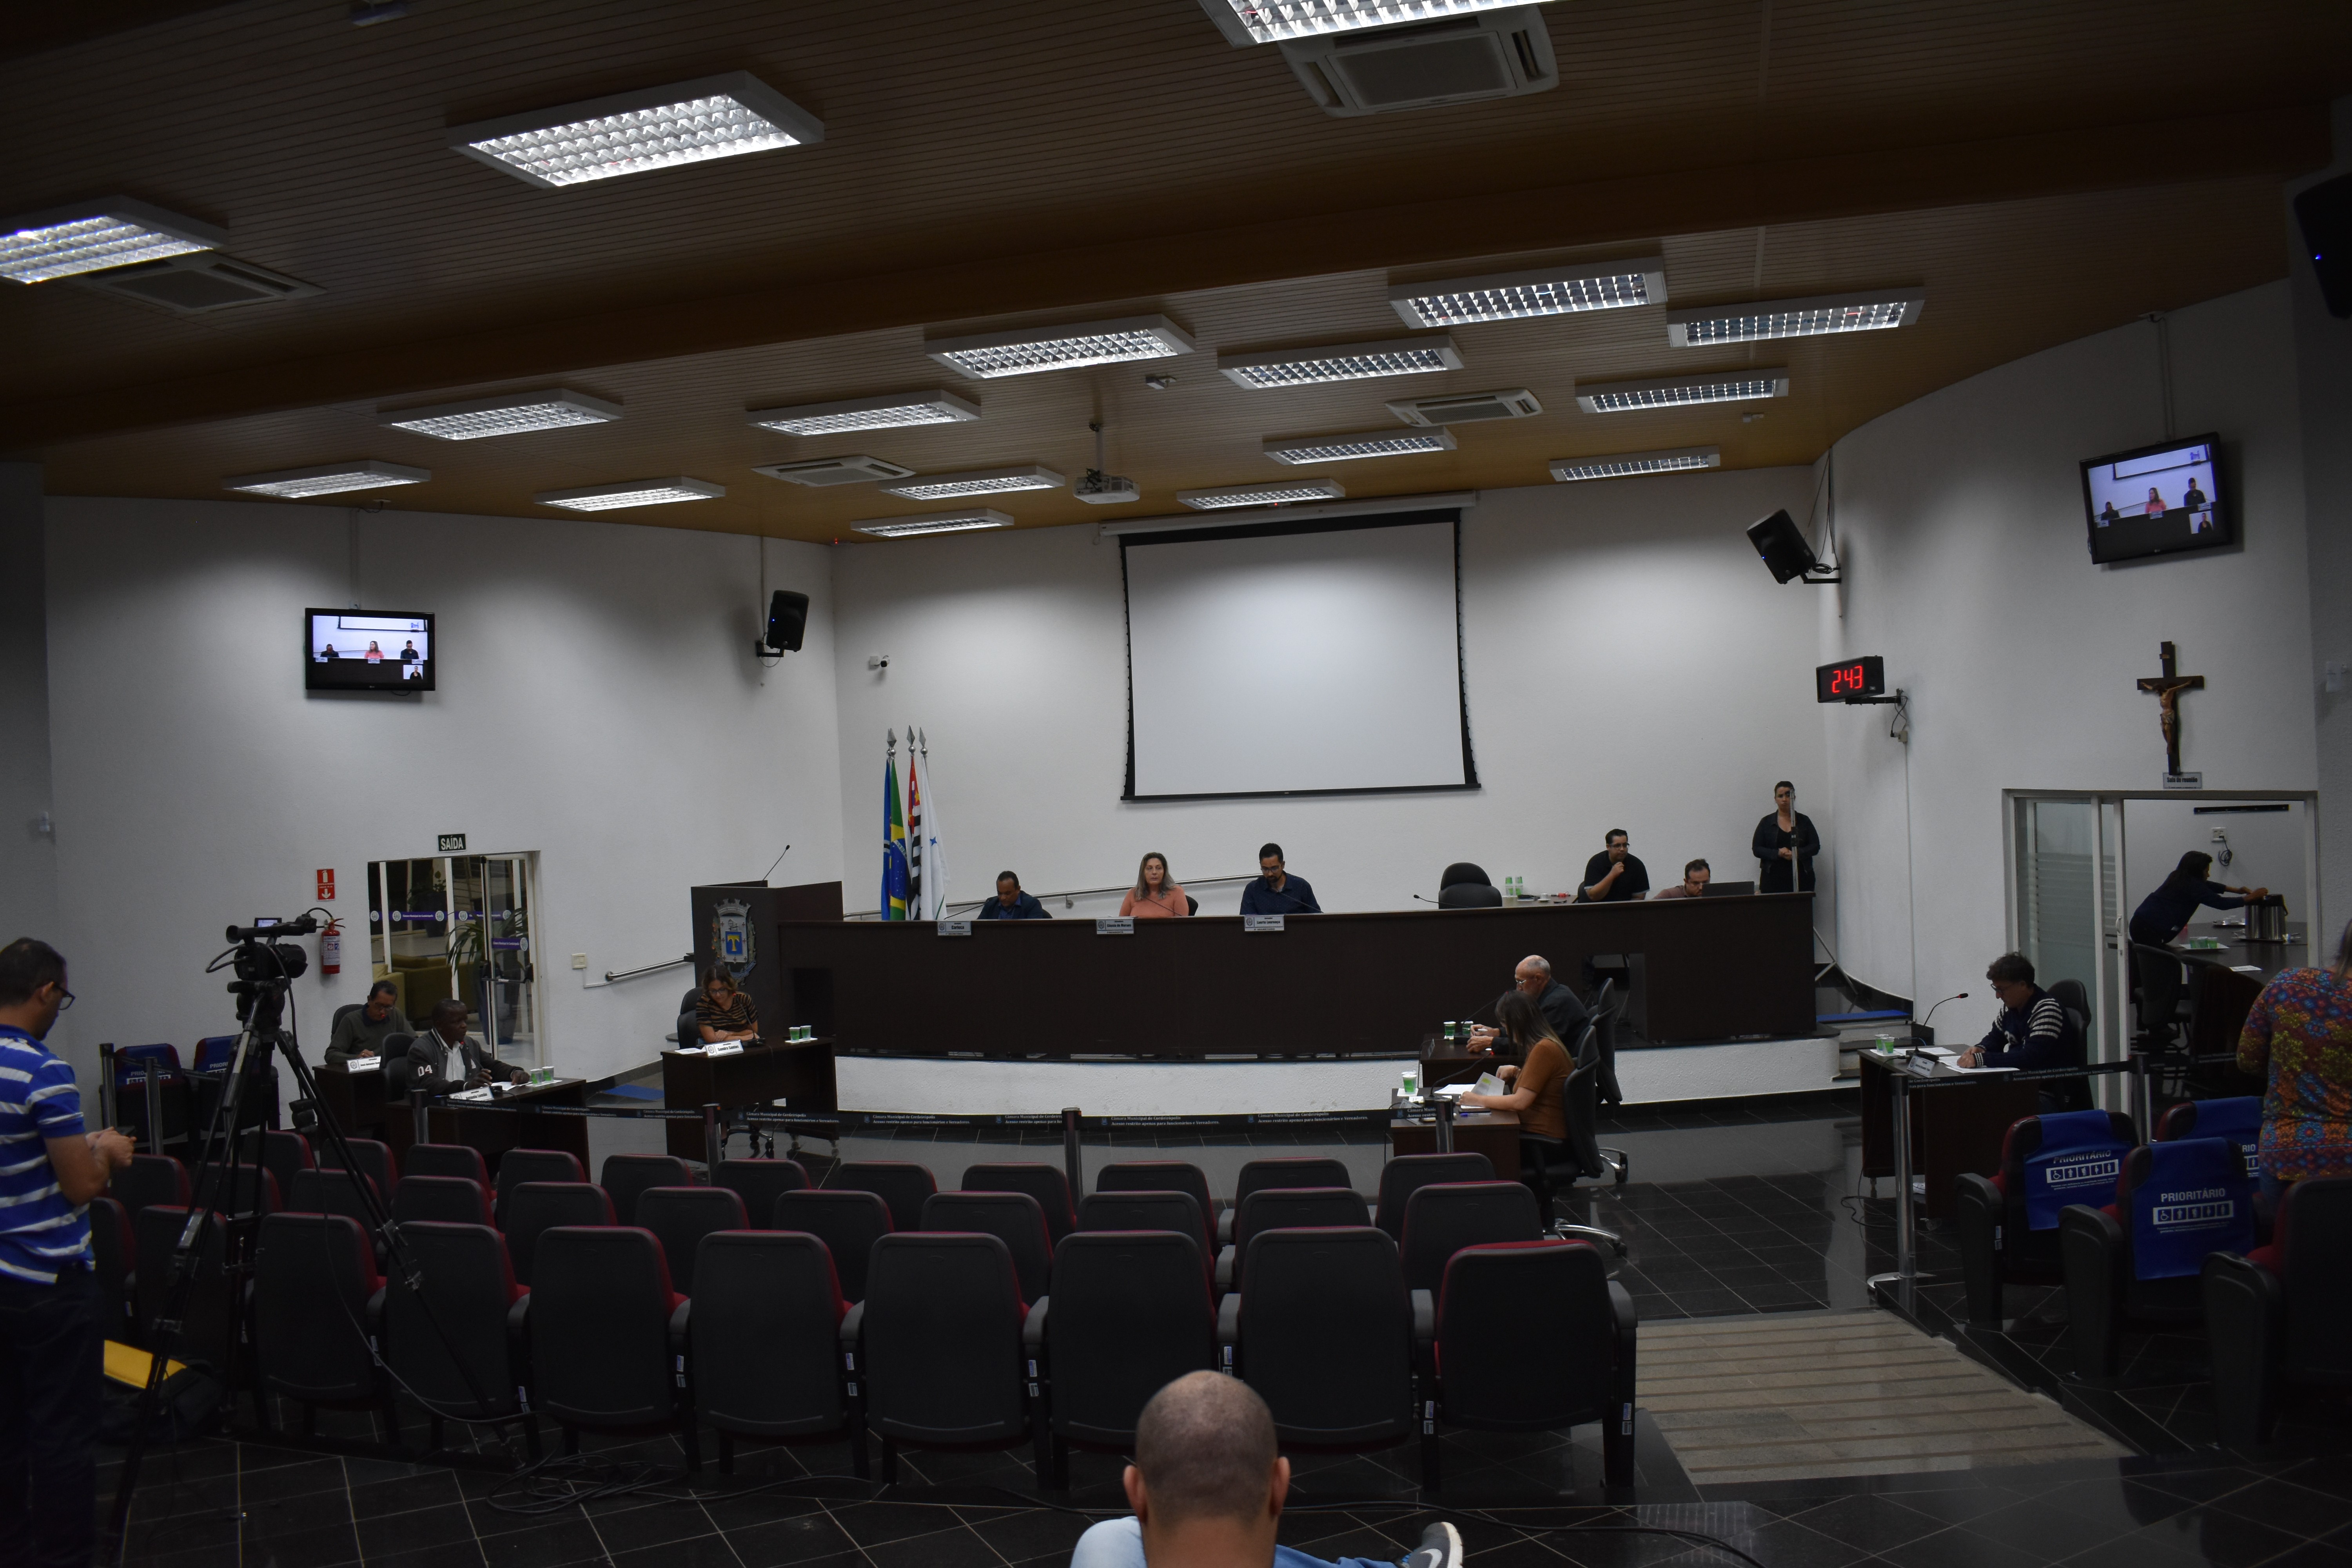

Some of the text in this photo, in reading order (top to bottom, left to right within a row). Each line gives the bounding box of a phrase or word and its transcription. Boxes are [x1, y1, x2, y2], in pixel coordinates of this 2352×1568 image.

[441, 835, 463, 850] SAÍDA
[417, 1065, 432, 1077] 04
[2053, 1150, 2112, 1163] PRIORITÁRIO
[2161, 1187, 2225, 1202] PRIORITÁRIO
